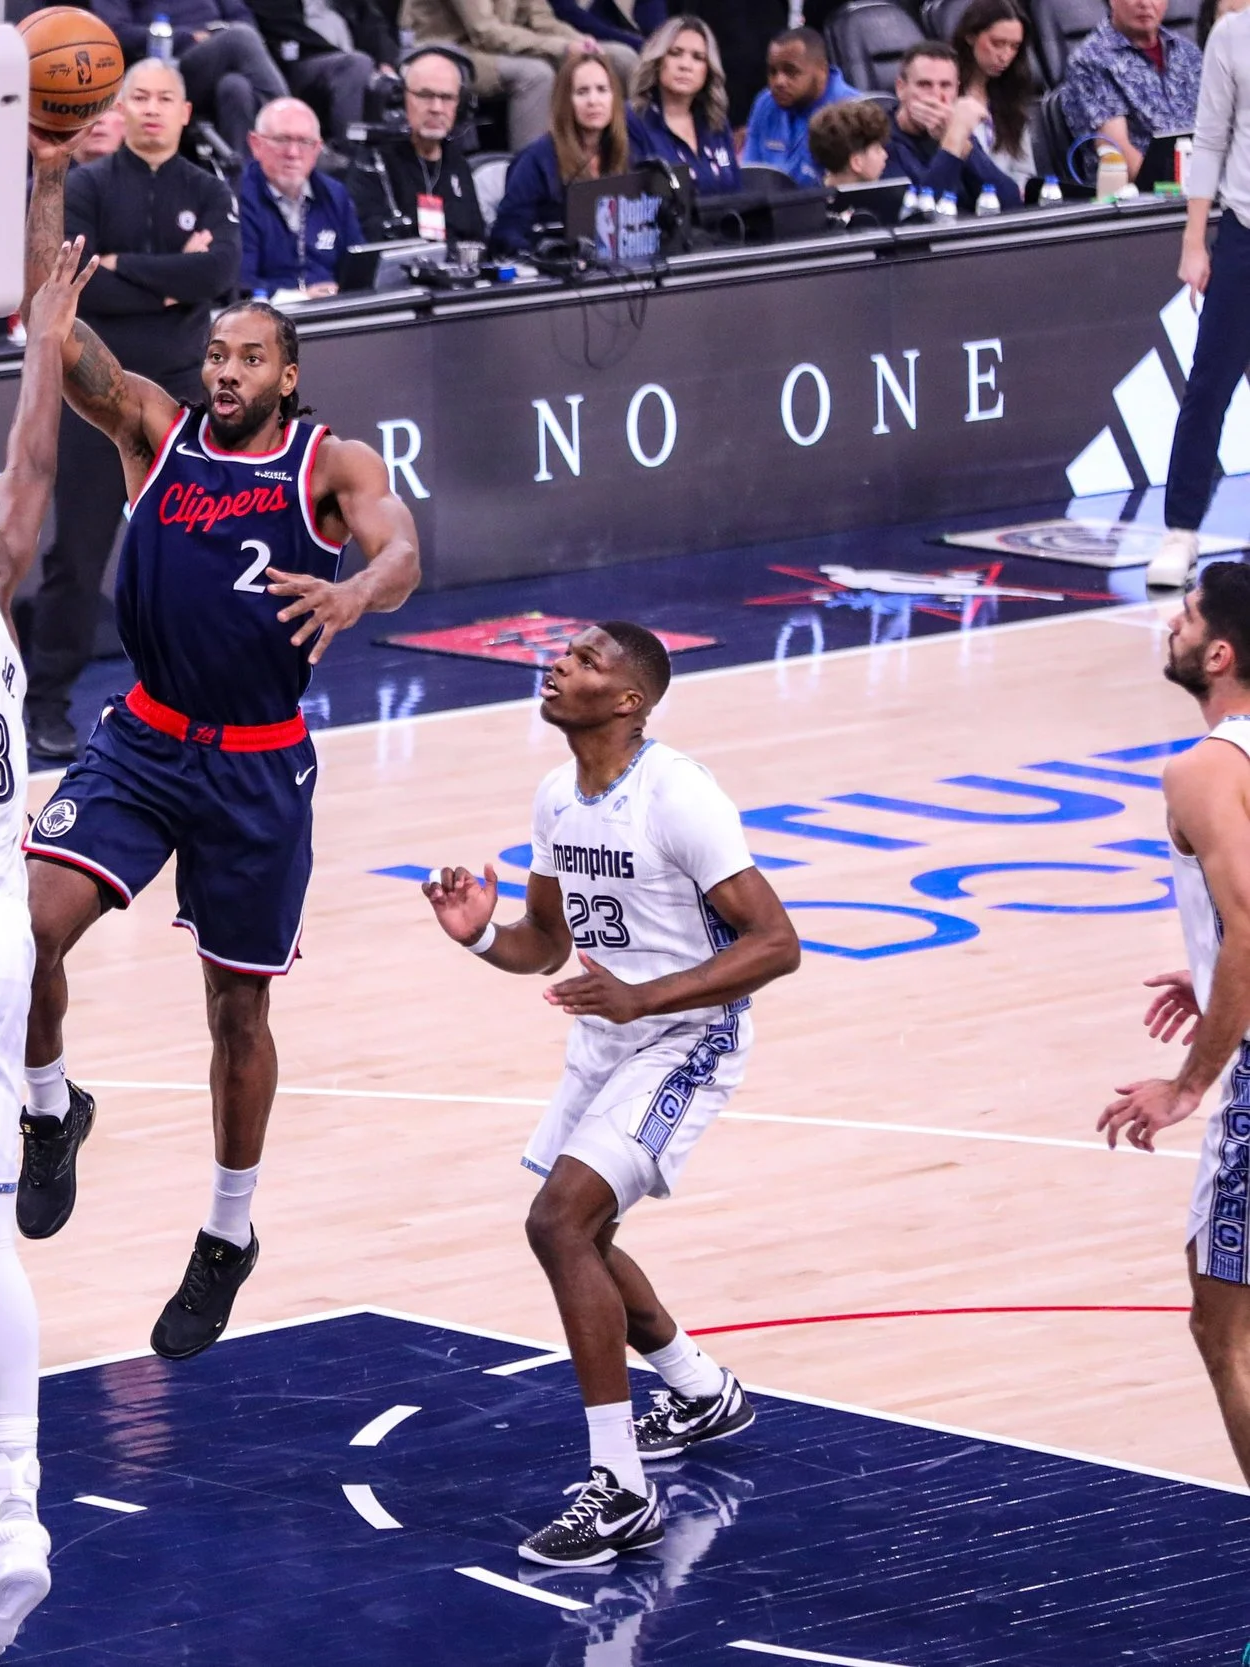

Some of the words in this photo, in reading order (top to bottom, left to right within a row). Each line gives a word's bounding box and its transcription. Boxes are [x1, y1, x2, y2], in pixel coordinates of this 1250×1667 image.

[532, 382, 678, 481] NO
[781, 338, 1004, 445] ONE
[159, 482, 288, 533] Clippers
[233, 539, 271, 594] 2
[552, 843, 635, 881] memphis
[567, 892, 631, 949] 23
